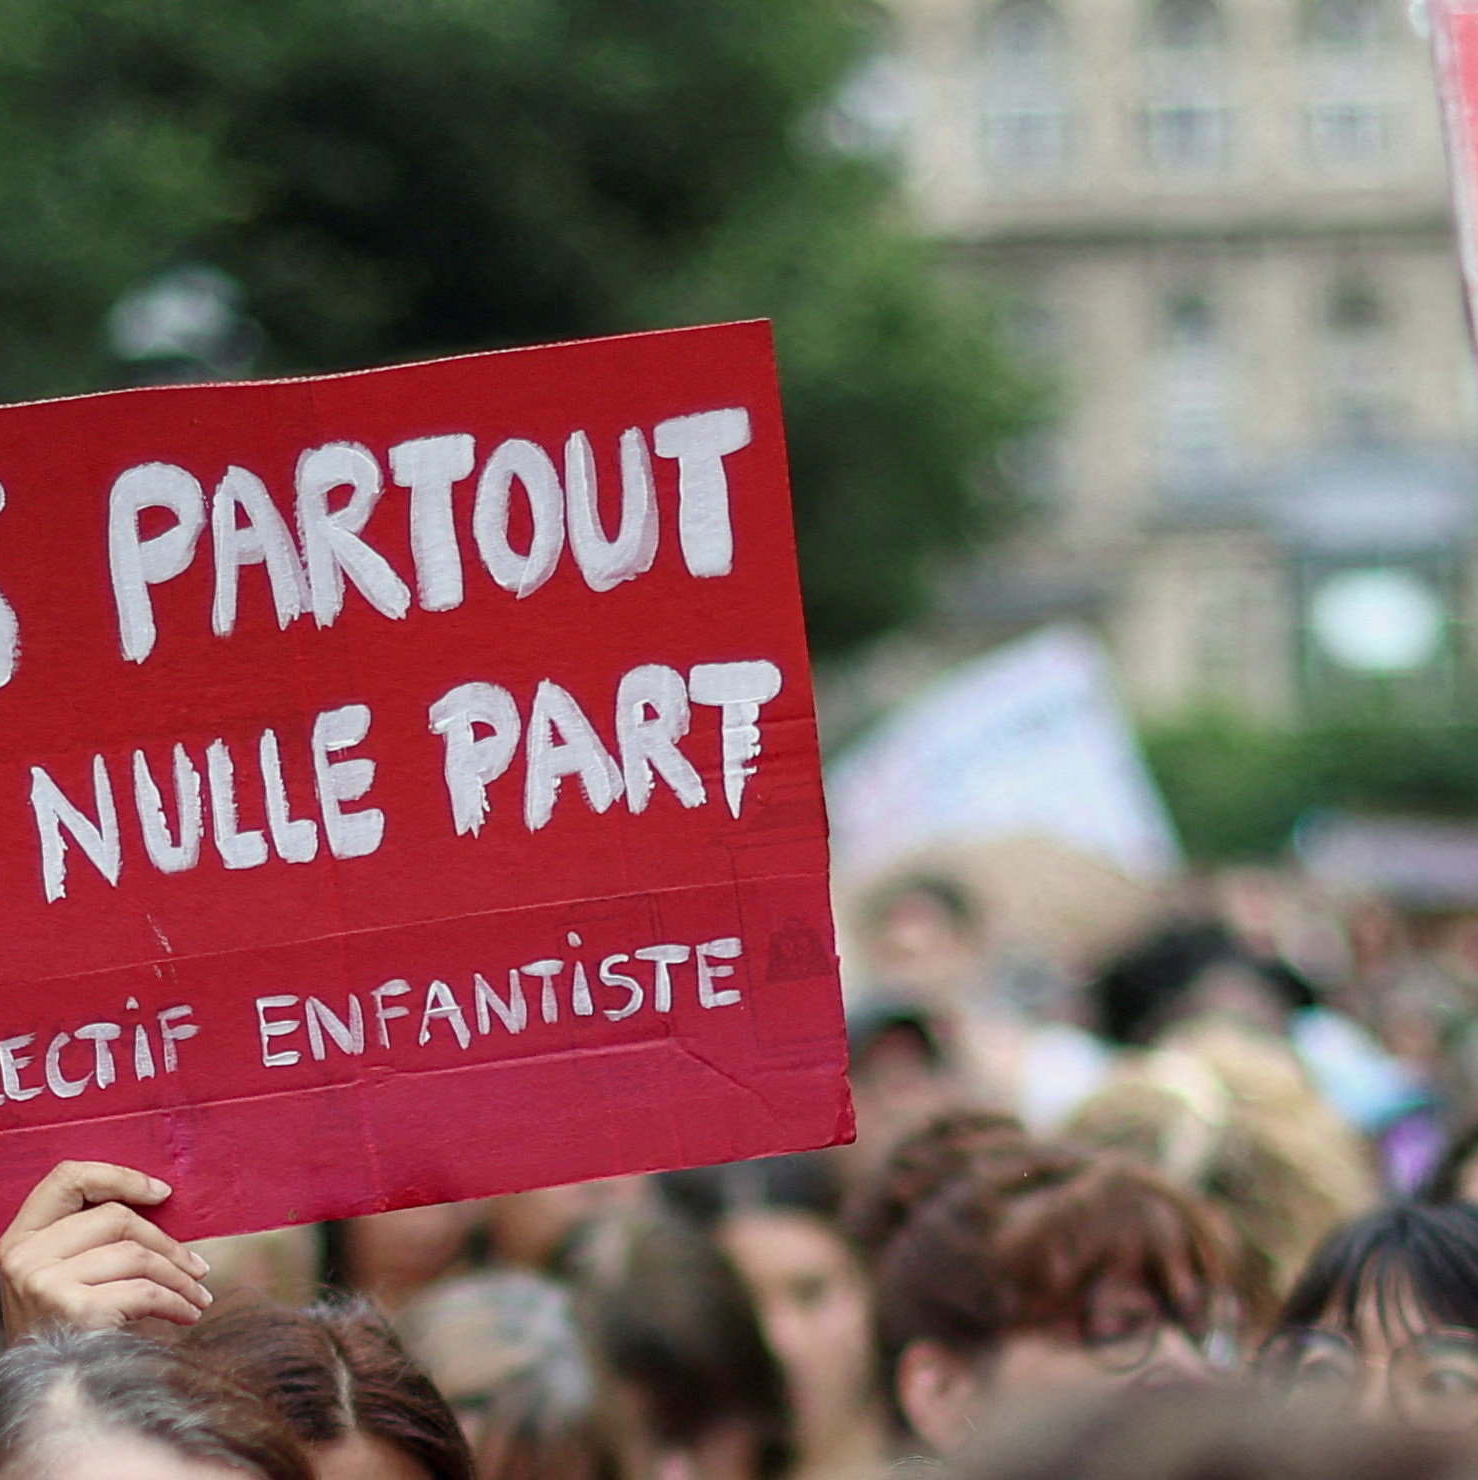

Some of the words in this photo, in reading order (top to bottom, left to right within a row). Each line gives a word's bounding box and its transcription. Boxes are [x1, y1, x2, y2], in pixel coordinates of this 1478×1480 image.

[108, 407, 752, 665] PARTOUT
[29, 704, 385, 904] NULLE
[428, 659, 782, 839] PART
